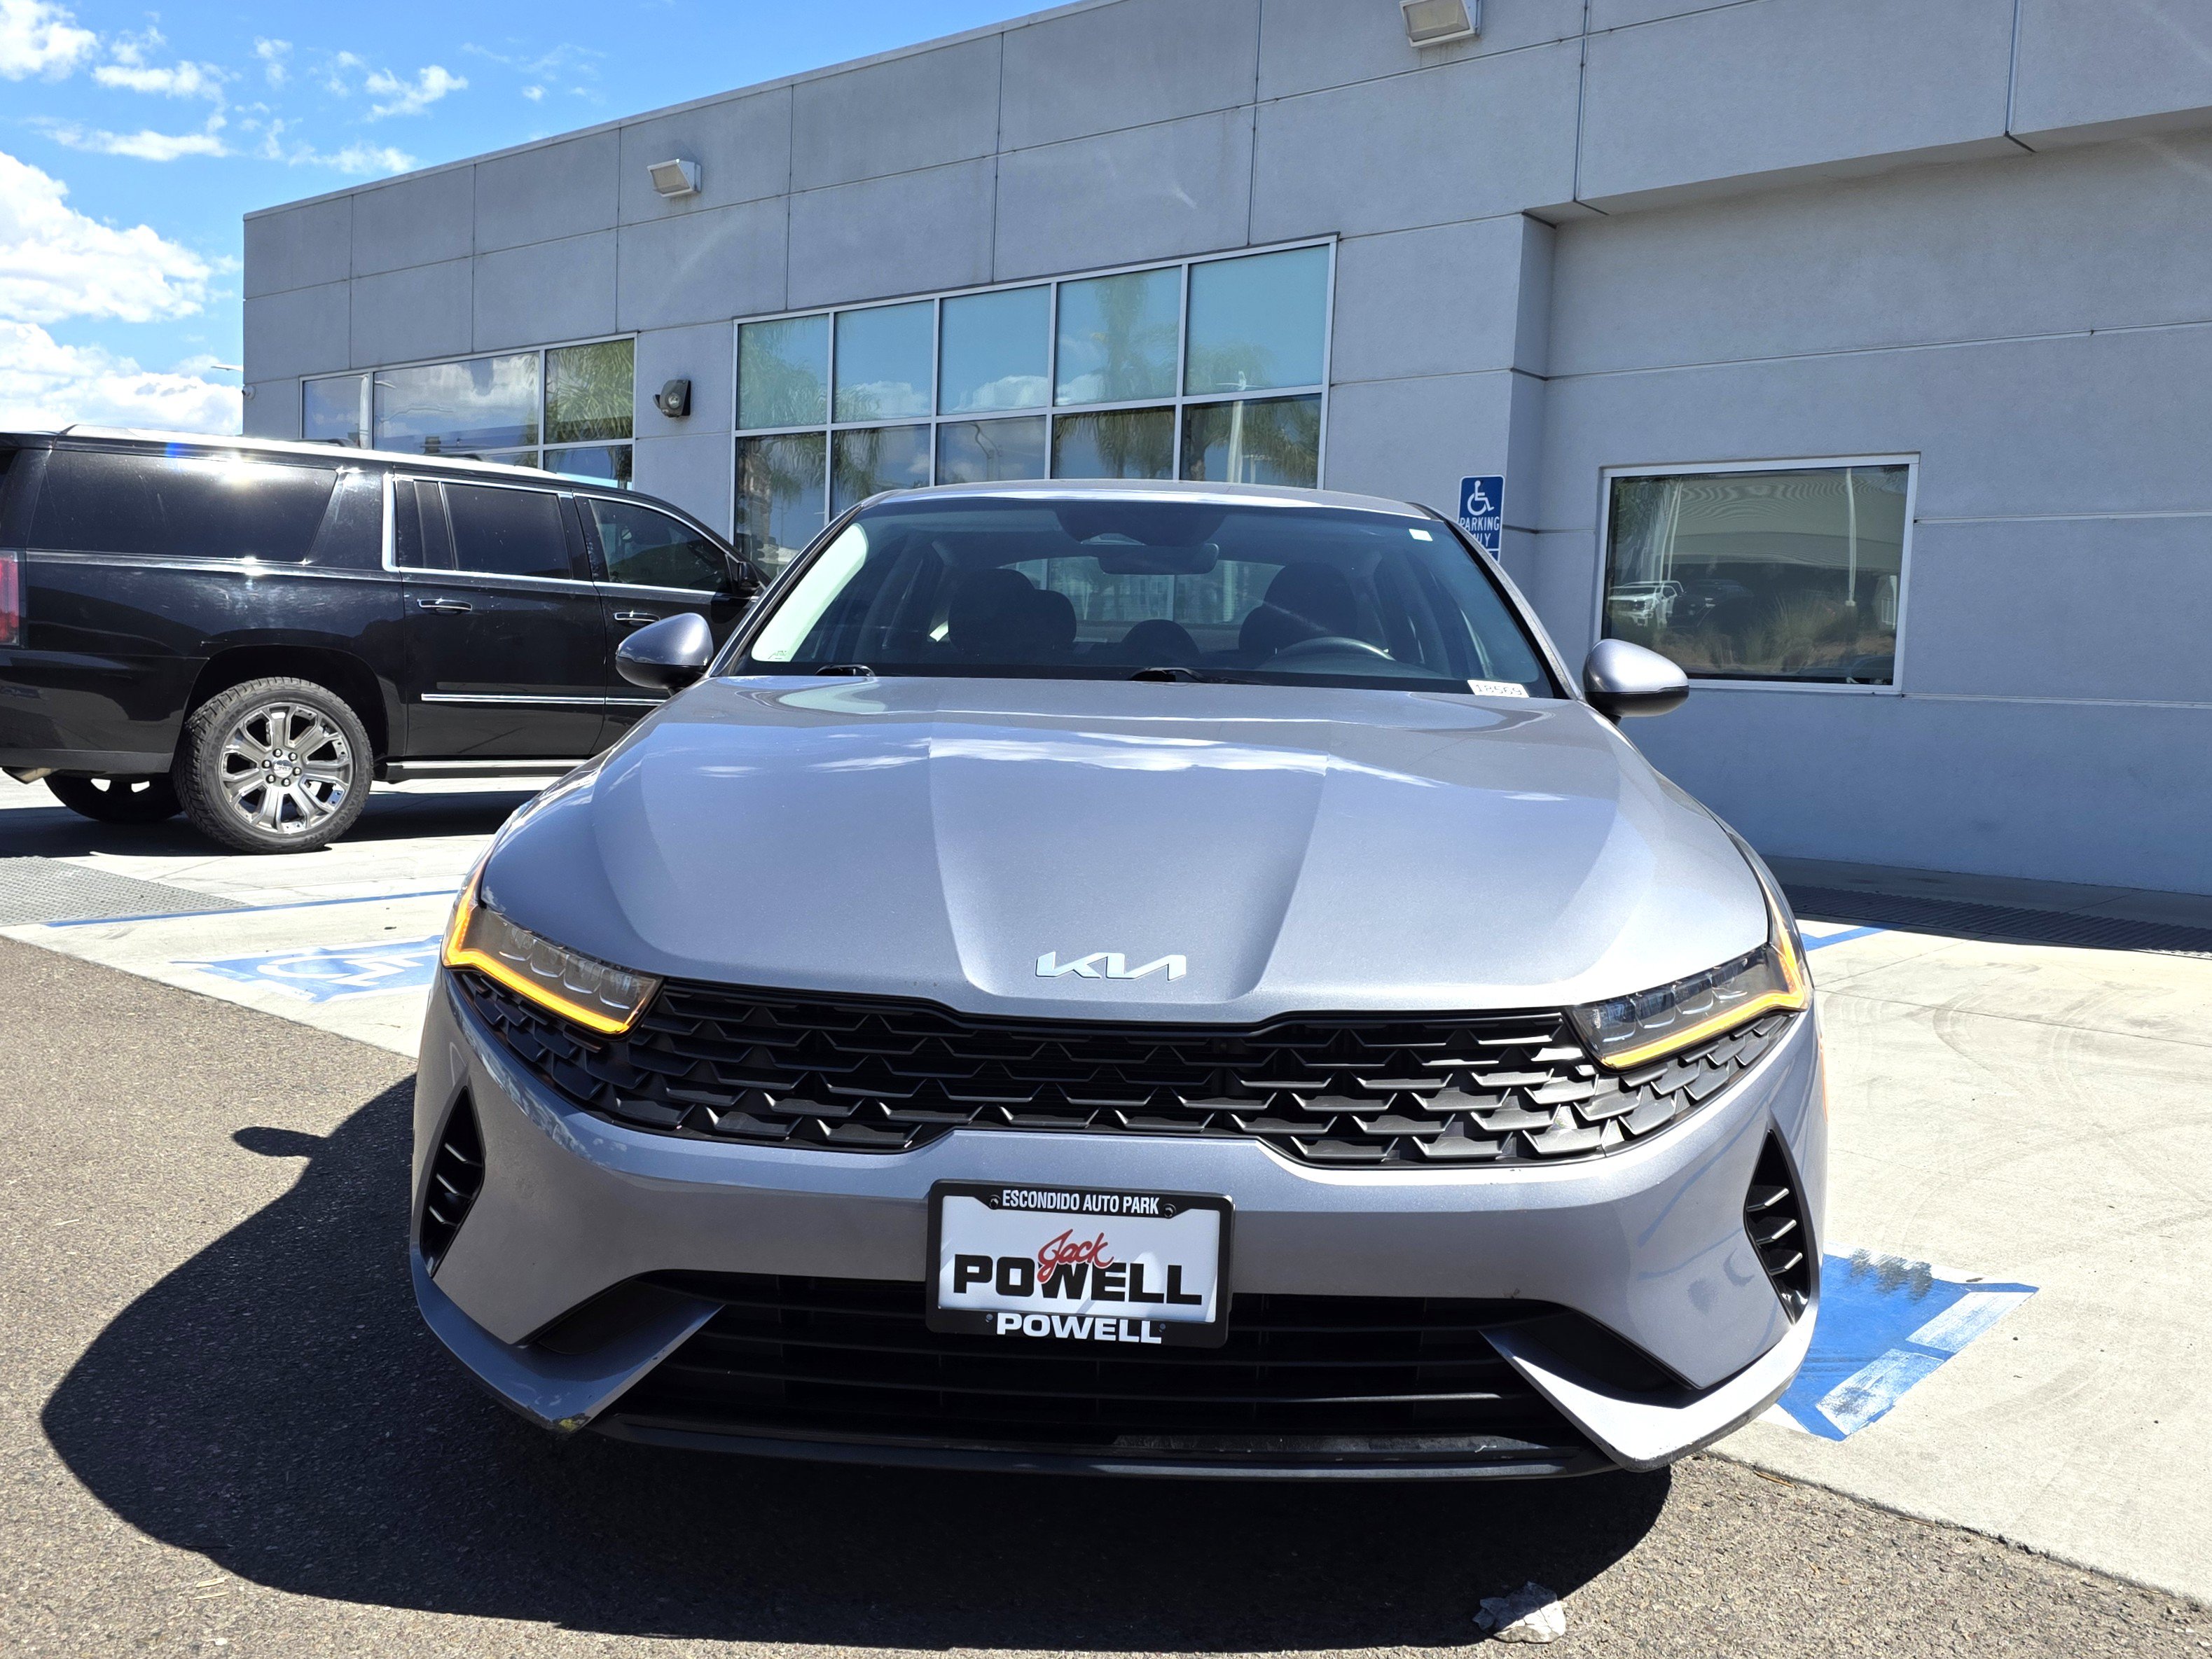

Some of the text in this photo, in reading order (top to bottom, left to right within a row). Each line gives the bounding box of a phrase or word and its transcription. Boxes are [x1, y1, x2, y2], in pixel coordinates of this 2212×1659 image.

[1460, 516, 1500, 531] PARKING
[1035, 951, 1187, 980] KIA
[1002, 1189, 1159, 1215] ESCONDIDO AUTO PARK
[1037, 1228, 1114, 1284] Jack
[953, 1254, 1202, 1305] POWELL
[996, 1312, 1162, 1344] POWELL
